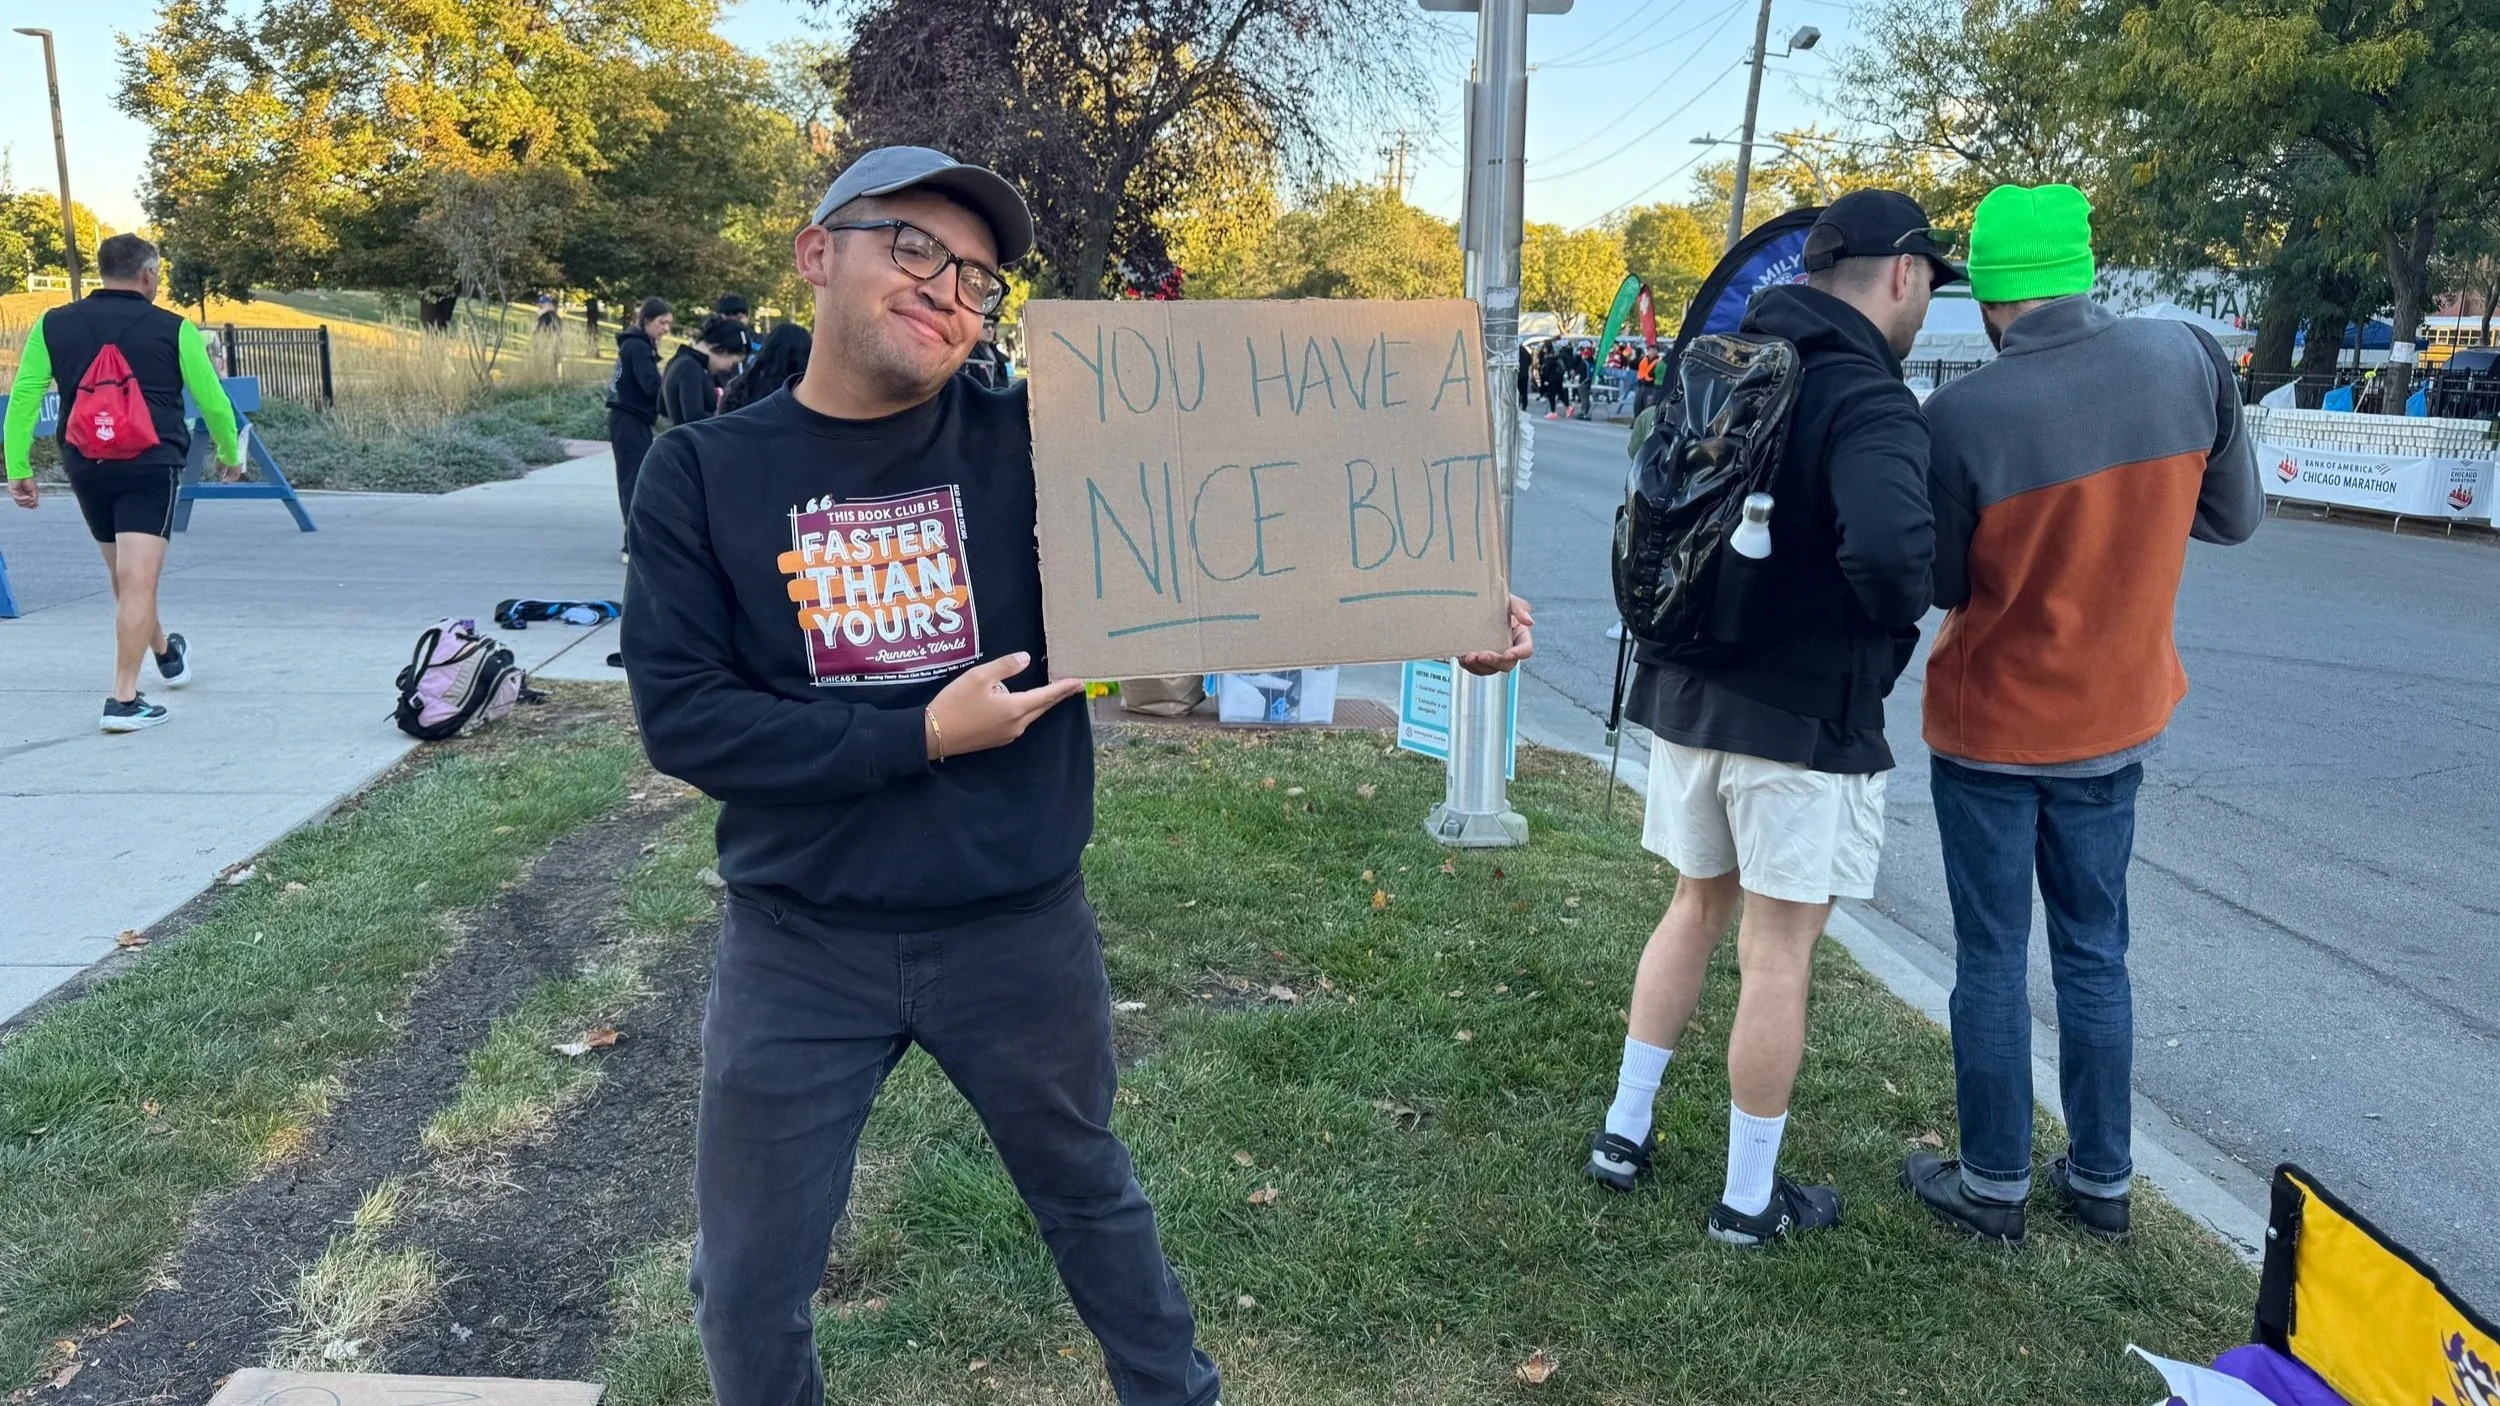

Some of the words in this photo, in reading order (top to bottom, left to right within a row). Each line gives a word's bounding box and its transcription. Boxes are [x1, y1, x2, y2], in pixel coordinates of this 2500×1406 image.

[1745, 253, 1801, 304] AMILY
[1052, 324, 1206, 423] YOU
[1247, 329, 1412, 418] HAVE
[1431, 329, 1473, 412] A
[2302, 471, 2341, 486] CHICAGO
[2343, 475, 2397, 494] MARATHON
[2304, 459, 2325, 469] BANK
[2326, 461, 2336, 470] OF
[2337, 463, 2373, 474] AMERICA
[2450, 471, 2478, 479] CHICAGO
[827, 511, 856, 523] THIS
[857, 508, 893, 522] BOOK
[895, 502, 926, 516] CLUB
[928, 499, 940, 511] IS
[801, 519, 949, 565] FASTER
[1085, 460, 1298, 604] NICE
[1345, 454, 1493, 571] BUTT
[805, 552, 956, 611] THAN
[812, 597, 965, 649] YOURS
[927, 637, 967, 654] World
[820, 675, 857, 683] CHICAGO
